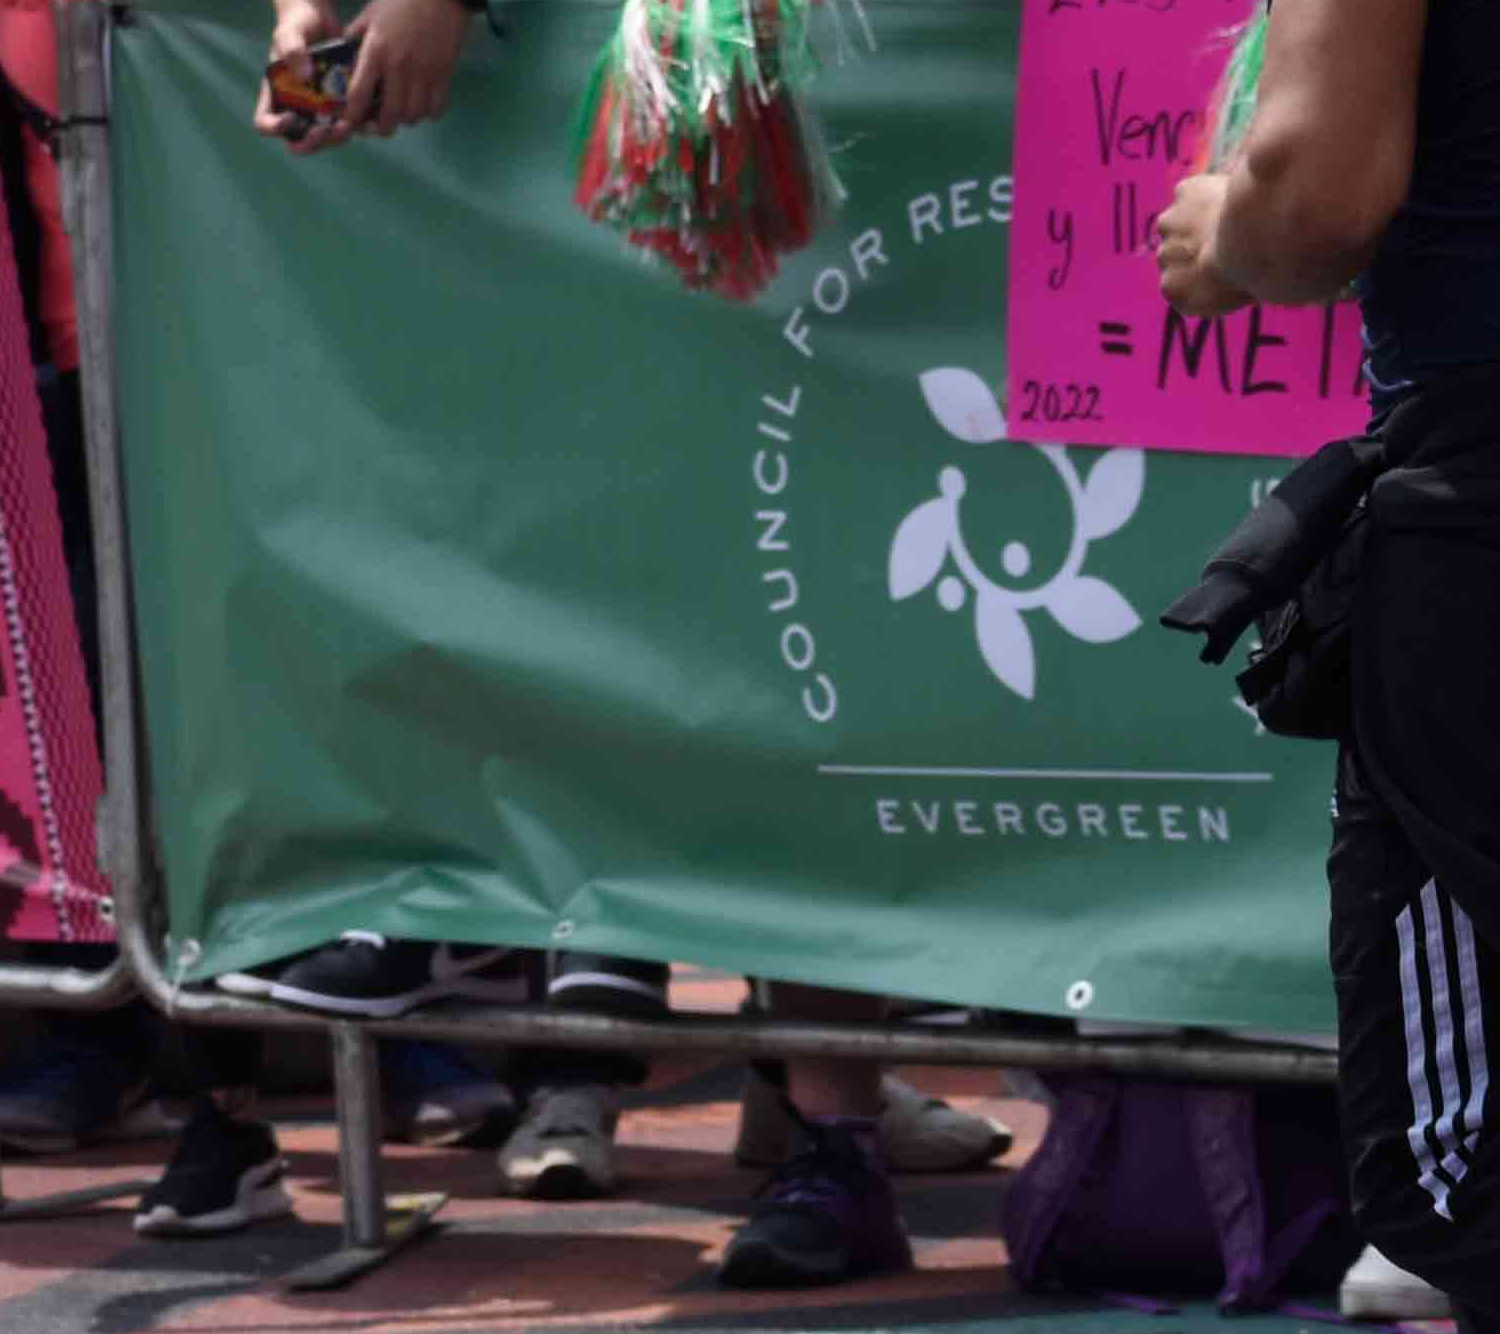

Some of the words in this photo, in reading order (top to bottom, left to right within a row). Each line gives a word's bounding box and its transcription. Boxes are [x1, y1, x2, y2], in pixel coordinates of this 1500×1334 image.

[1091, 67, 1194, 167] Venc
[908, 175, 1013, 242] RES
[1047, 207, 1075, 290] y
[783, 228, 888, 357] FOR
[1020, 381, 1102, 422] 2022
[752, 386, 837, 722] COUNCIL
[875, 798, 1231, 842] EVERGREEN
